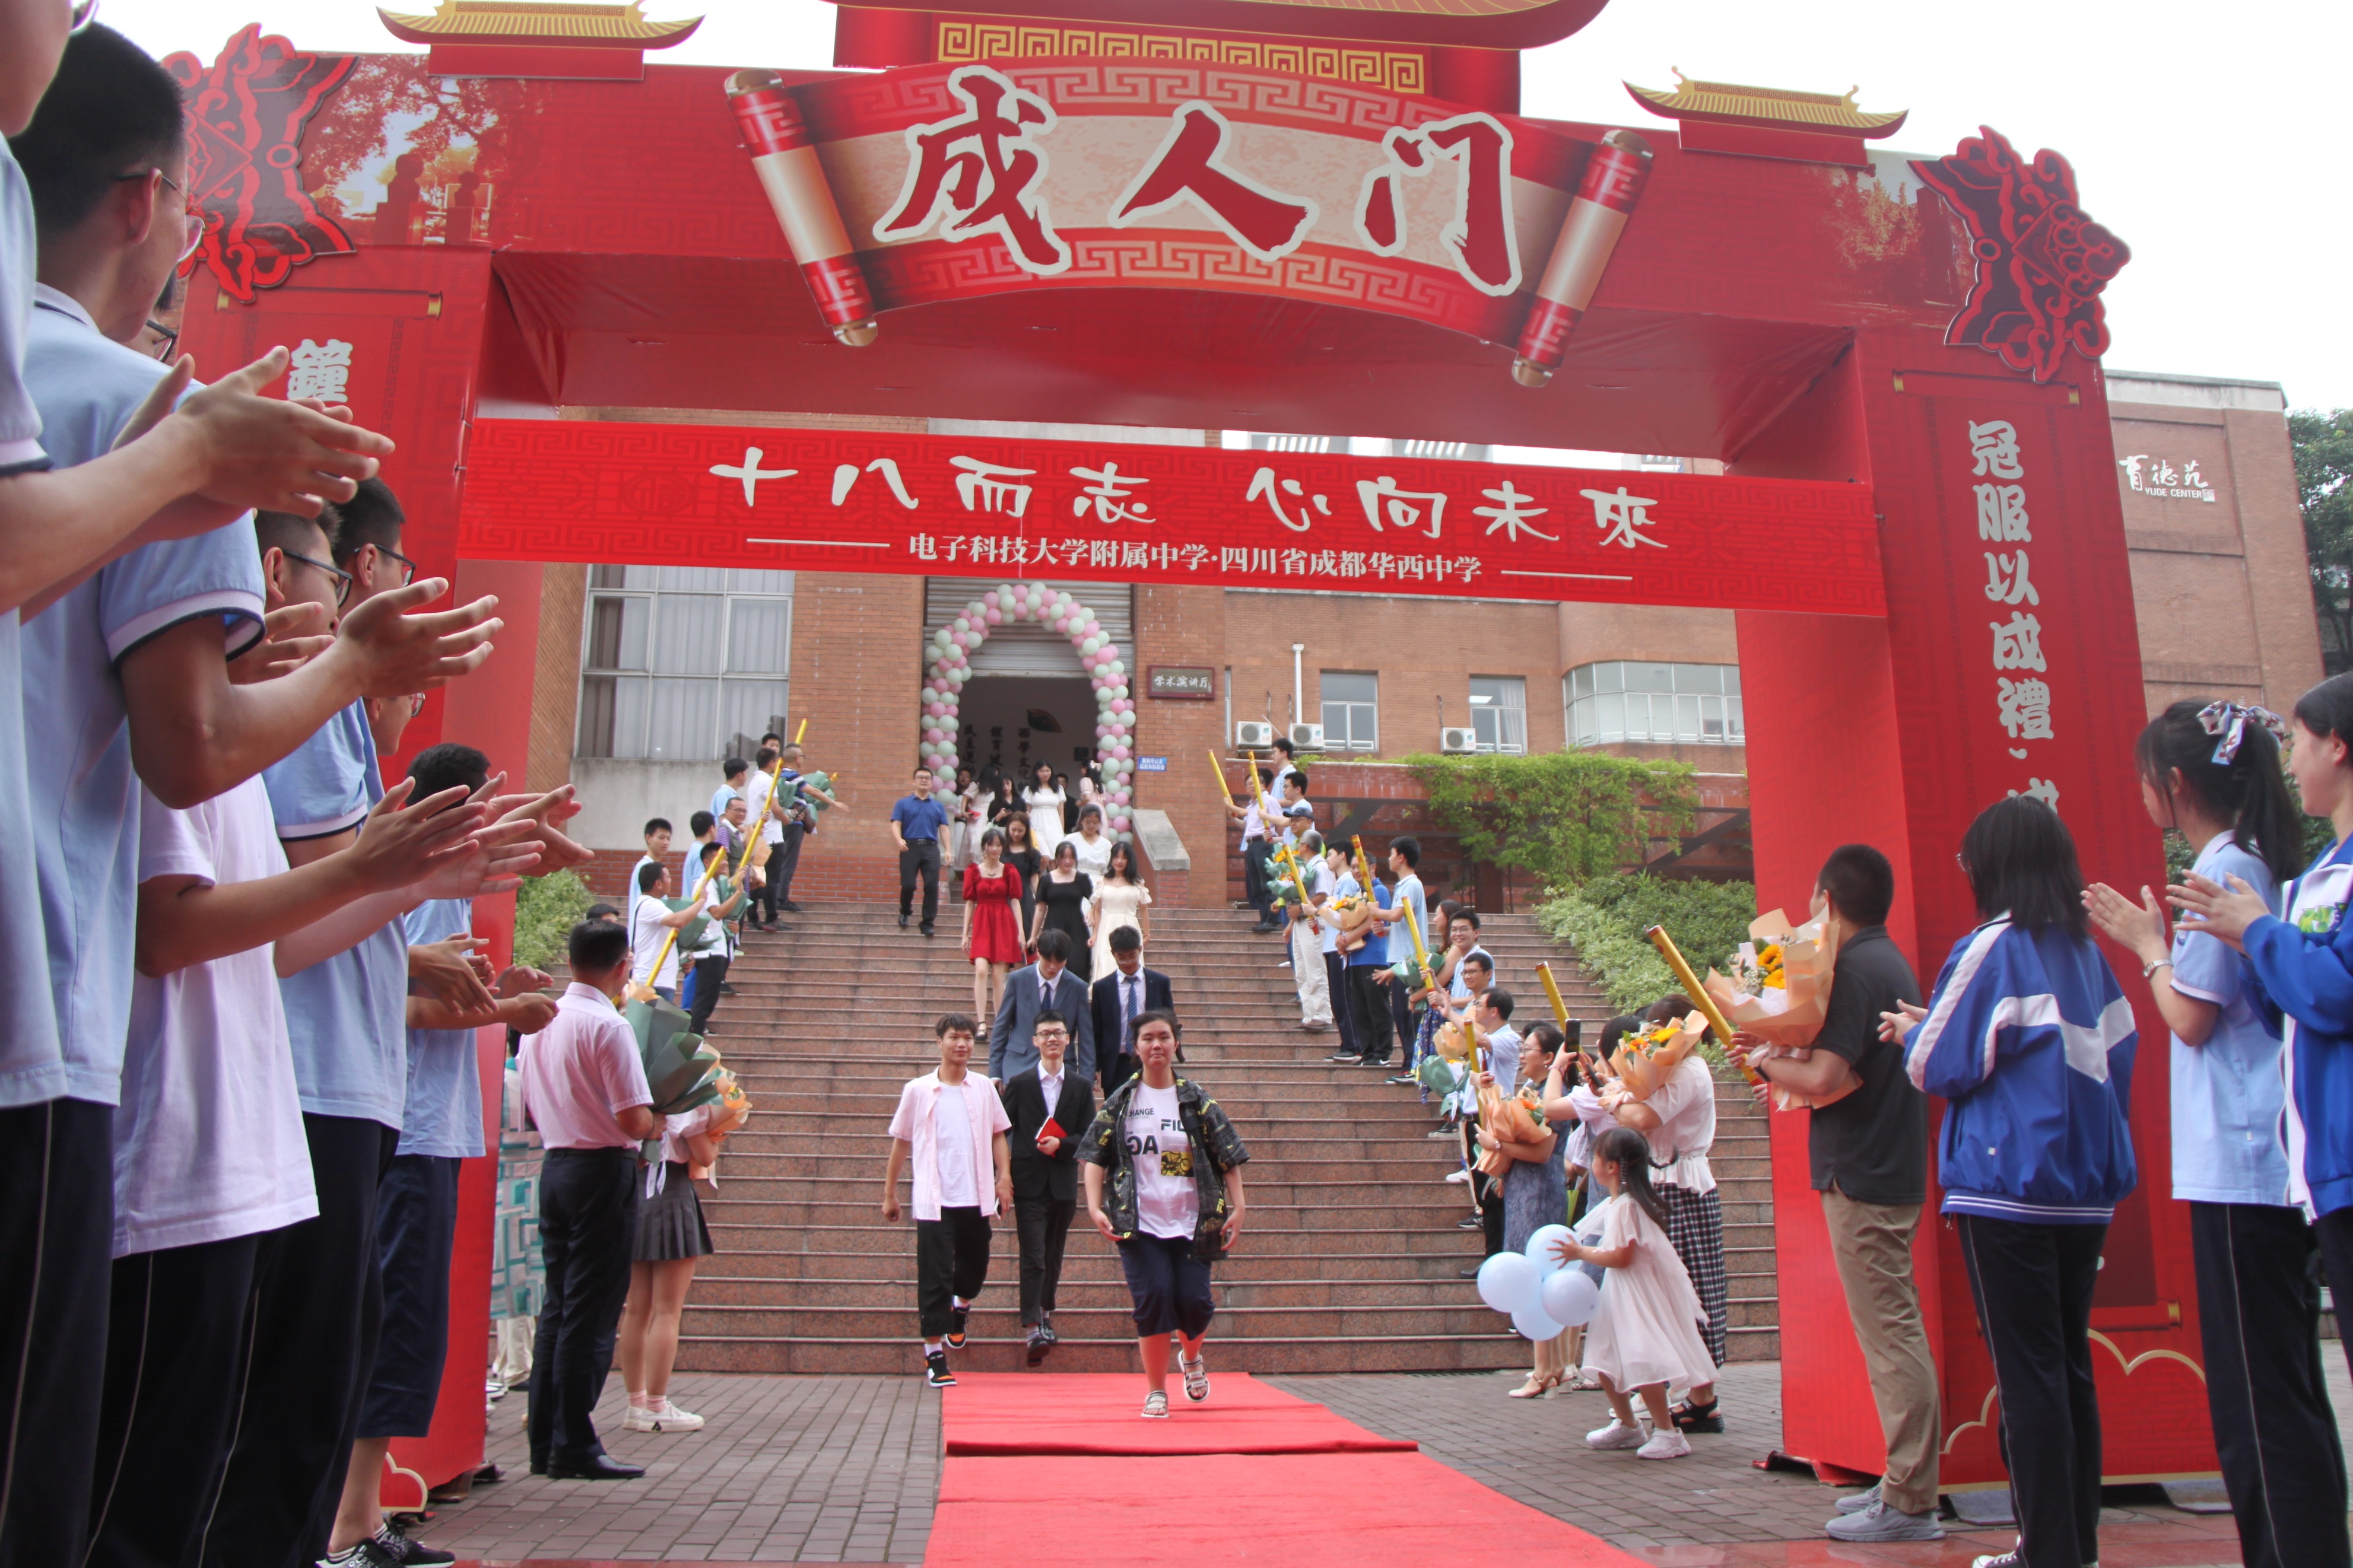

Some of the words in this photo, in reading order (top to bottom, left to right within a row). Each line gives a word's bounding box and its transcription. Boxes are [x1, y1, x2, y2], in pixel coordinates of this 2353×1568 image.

[874, 65, 1523, 297] 成人门
[709, 446, 1157, 523] 十八而志
[2119, 454, 2209, 491] 育德苑
[2144, 486, 2168, 497] YUDE
[2170, 488, 2202, 498] CENTER
[910, 533, 1482, 583] 电子科技大学附属中学·四川省成都华西中学
[1154, 675, 1208, 688] 学术演讲厅
[1161, 1118, 1186, 1132] FIL
